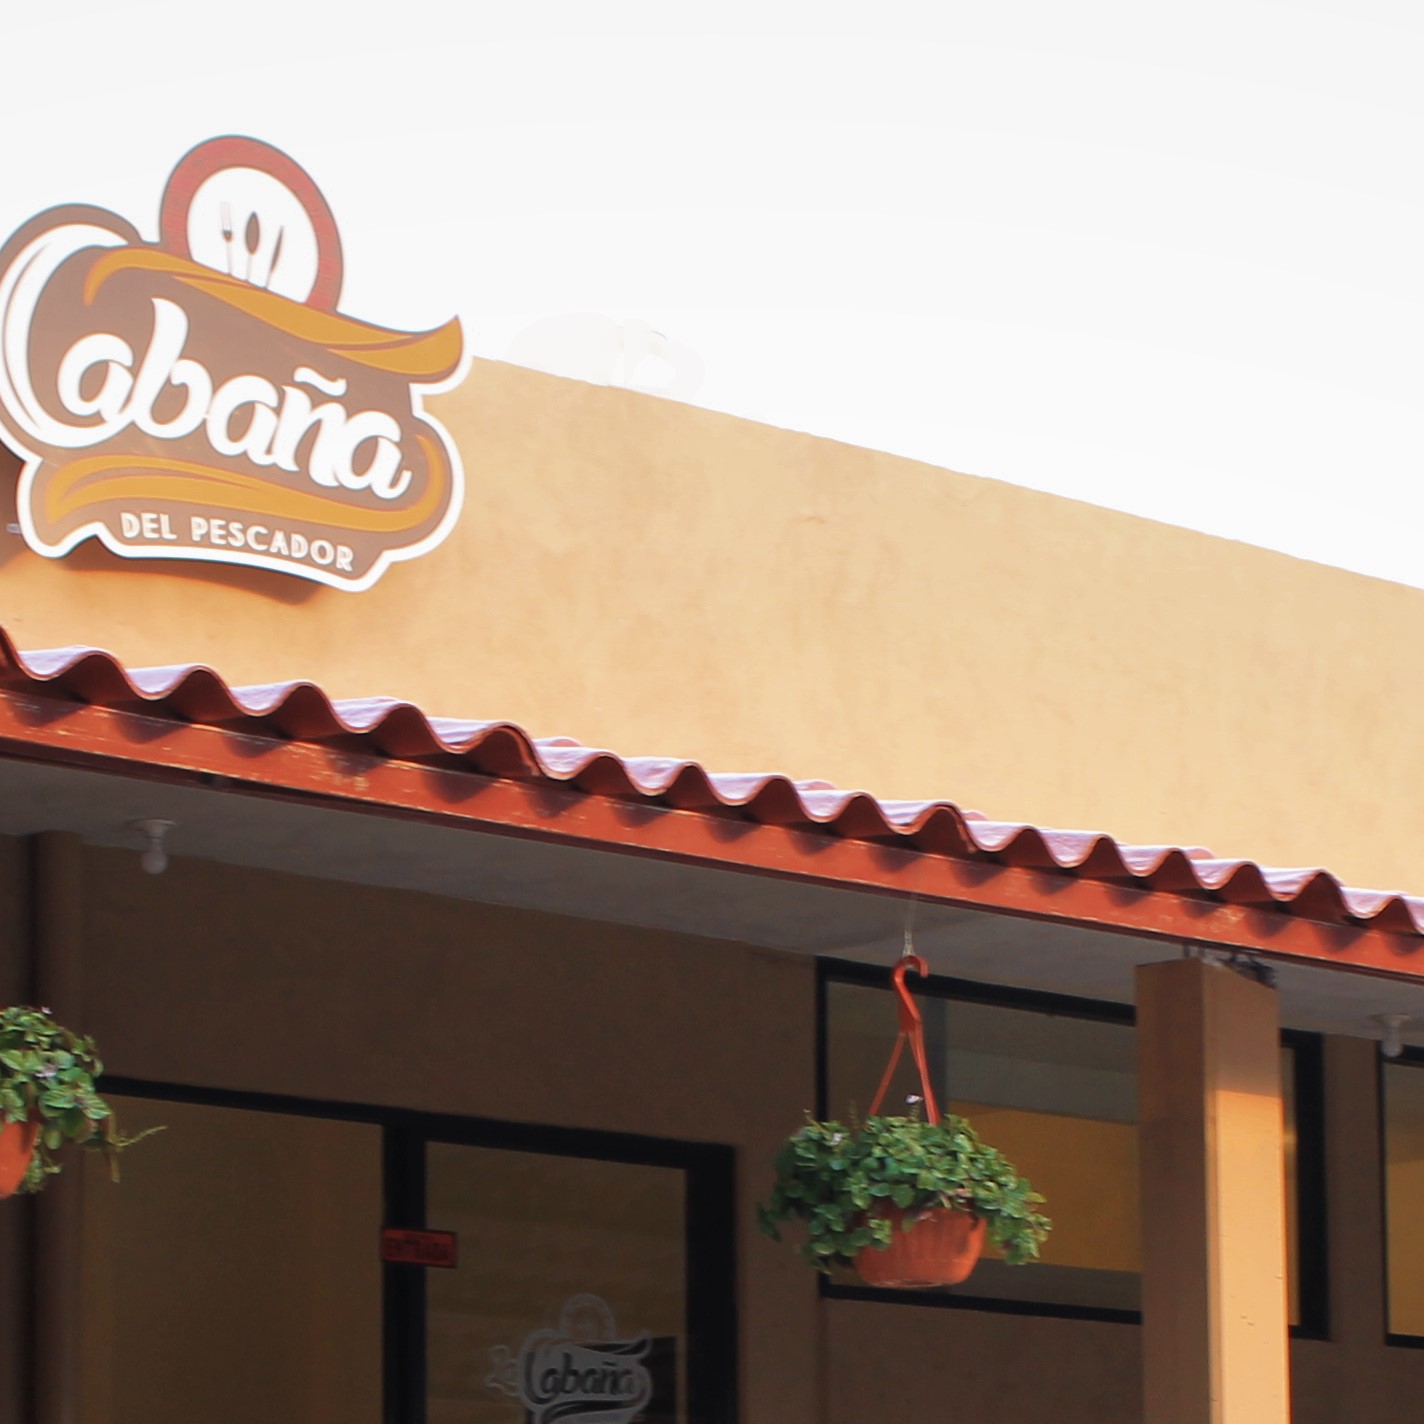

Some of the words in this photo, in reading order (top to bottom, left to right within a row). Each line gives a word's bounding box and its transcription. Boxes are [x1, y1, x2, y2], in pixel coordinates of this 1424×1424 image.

[120, 511, 178, 541] DEL
[190, 515, 354, 572] PESCADOR
[523, 1339, 636, 1405] Cabaña
